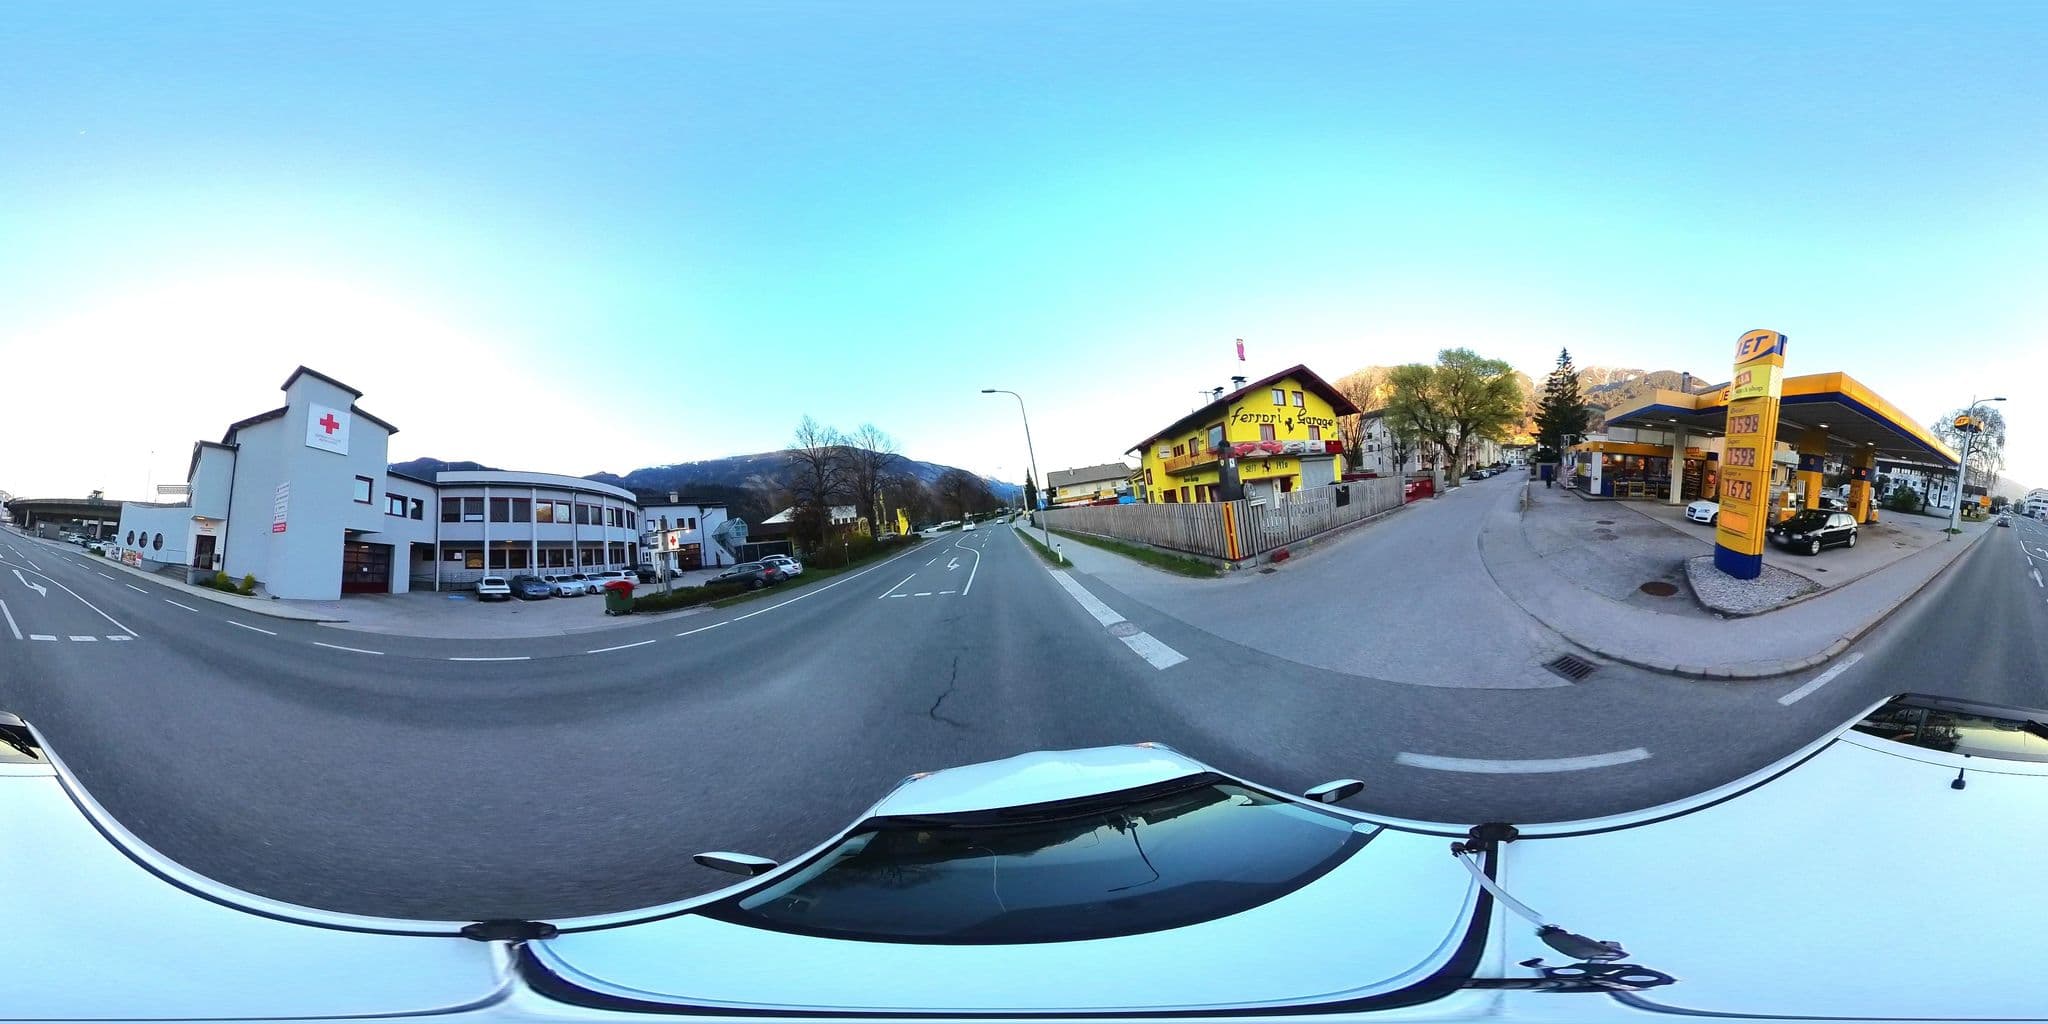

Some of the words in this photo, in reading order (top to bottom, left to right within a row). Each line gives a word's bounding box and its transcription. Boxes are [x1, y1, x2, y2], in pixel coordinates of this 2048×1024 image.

[1736, 335, 1769, 357] JET
[1728, 448, 1754, 466] 1598
[1726, 478, 1752, 501] 1678
